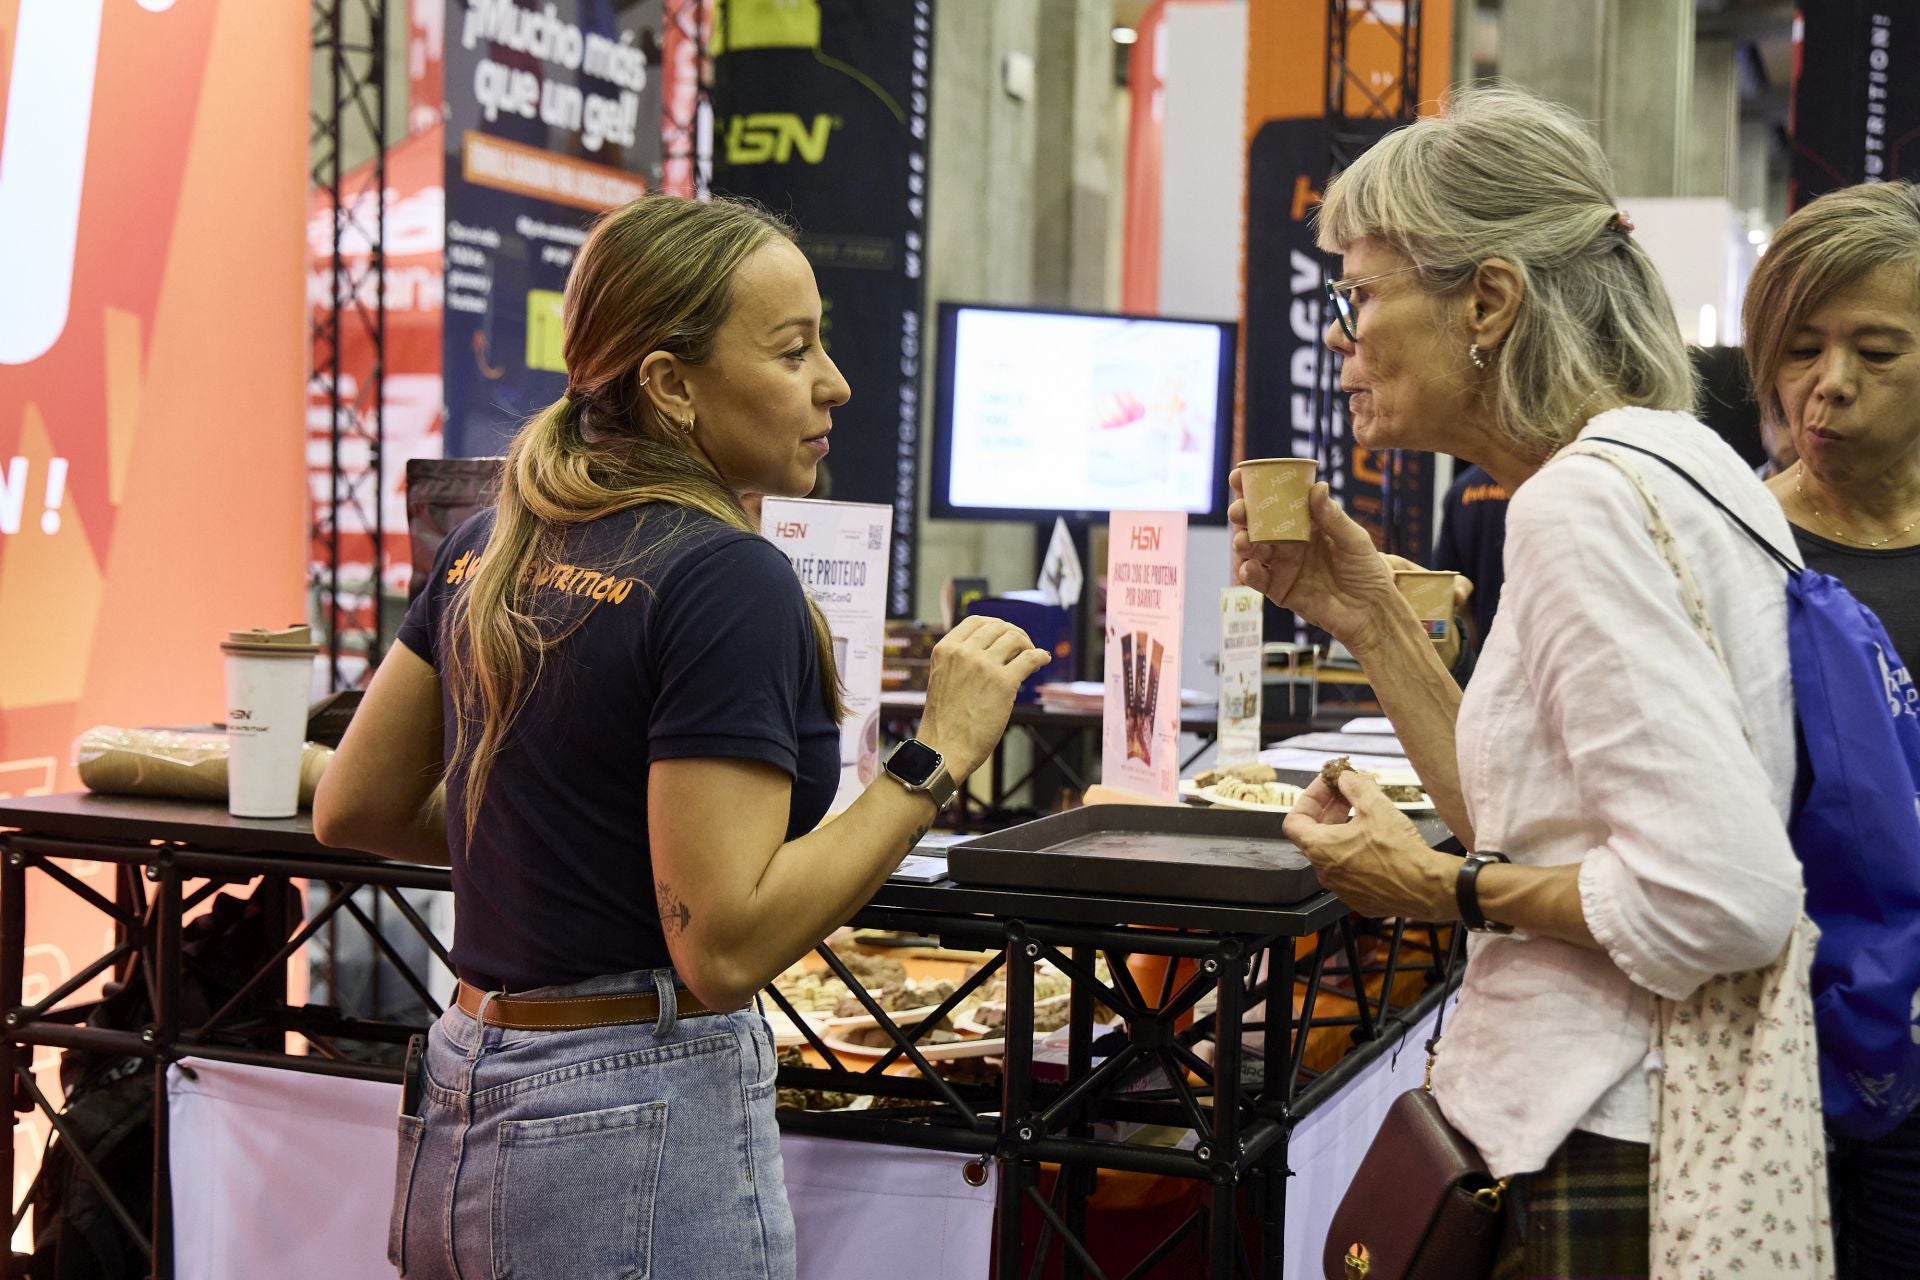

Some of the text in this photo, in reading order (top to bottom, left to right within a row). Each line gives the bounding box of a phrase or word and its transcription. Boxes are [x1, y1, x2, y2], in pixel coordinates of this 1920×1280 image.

[582, 30, 647, 92] más
[474, 58, 639, 151] que un gel!
[776, 521, 808, 540] HSN
[1130, 525, 1161, 551] HSN
[816, 559, 867, 586] PROTEICO
